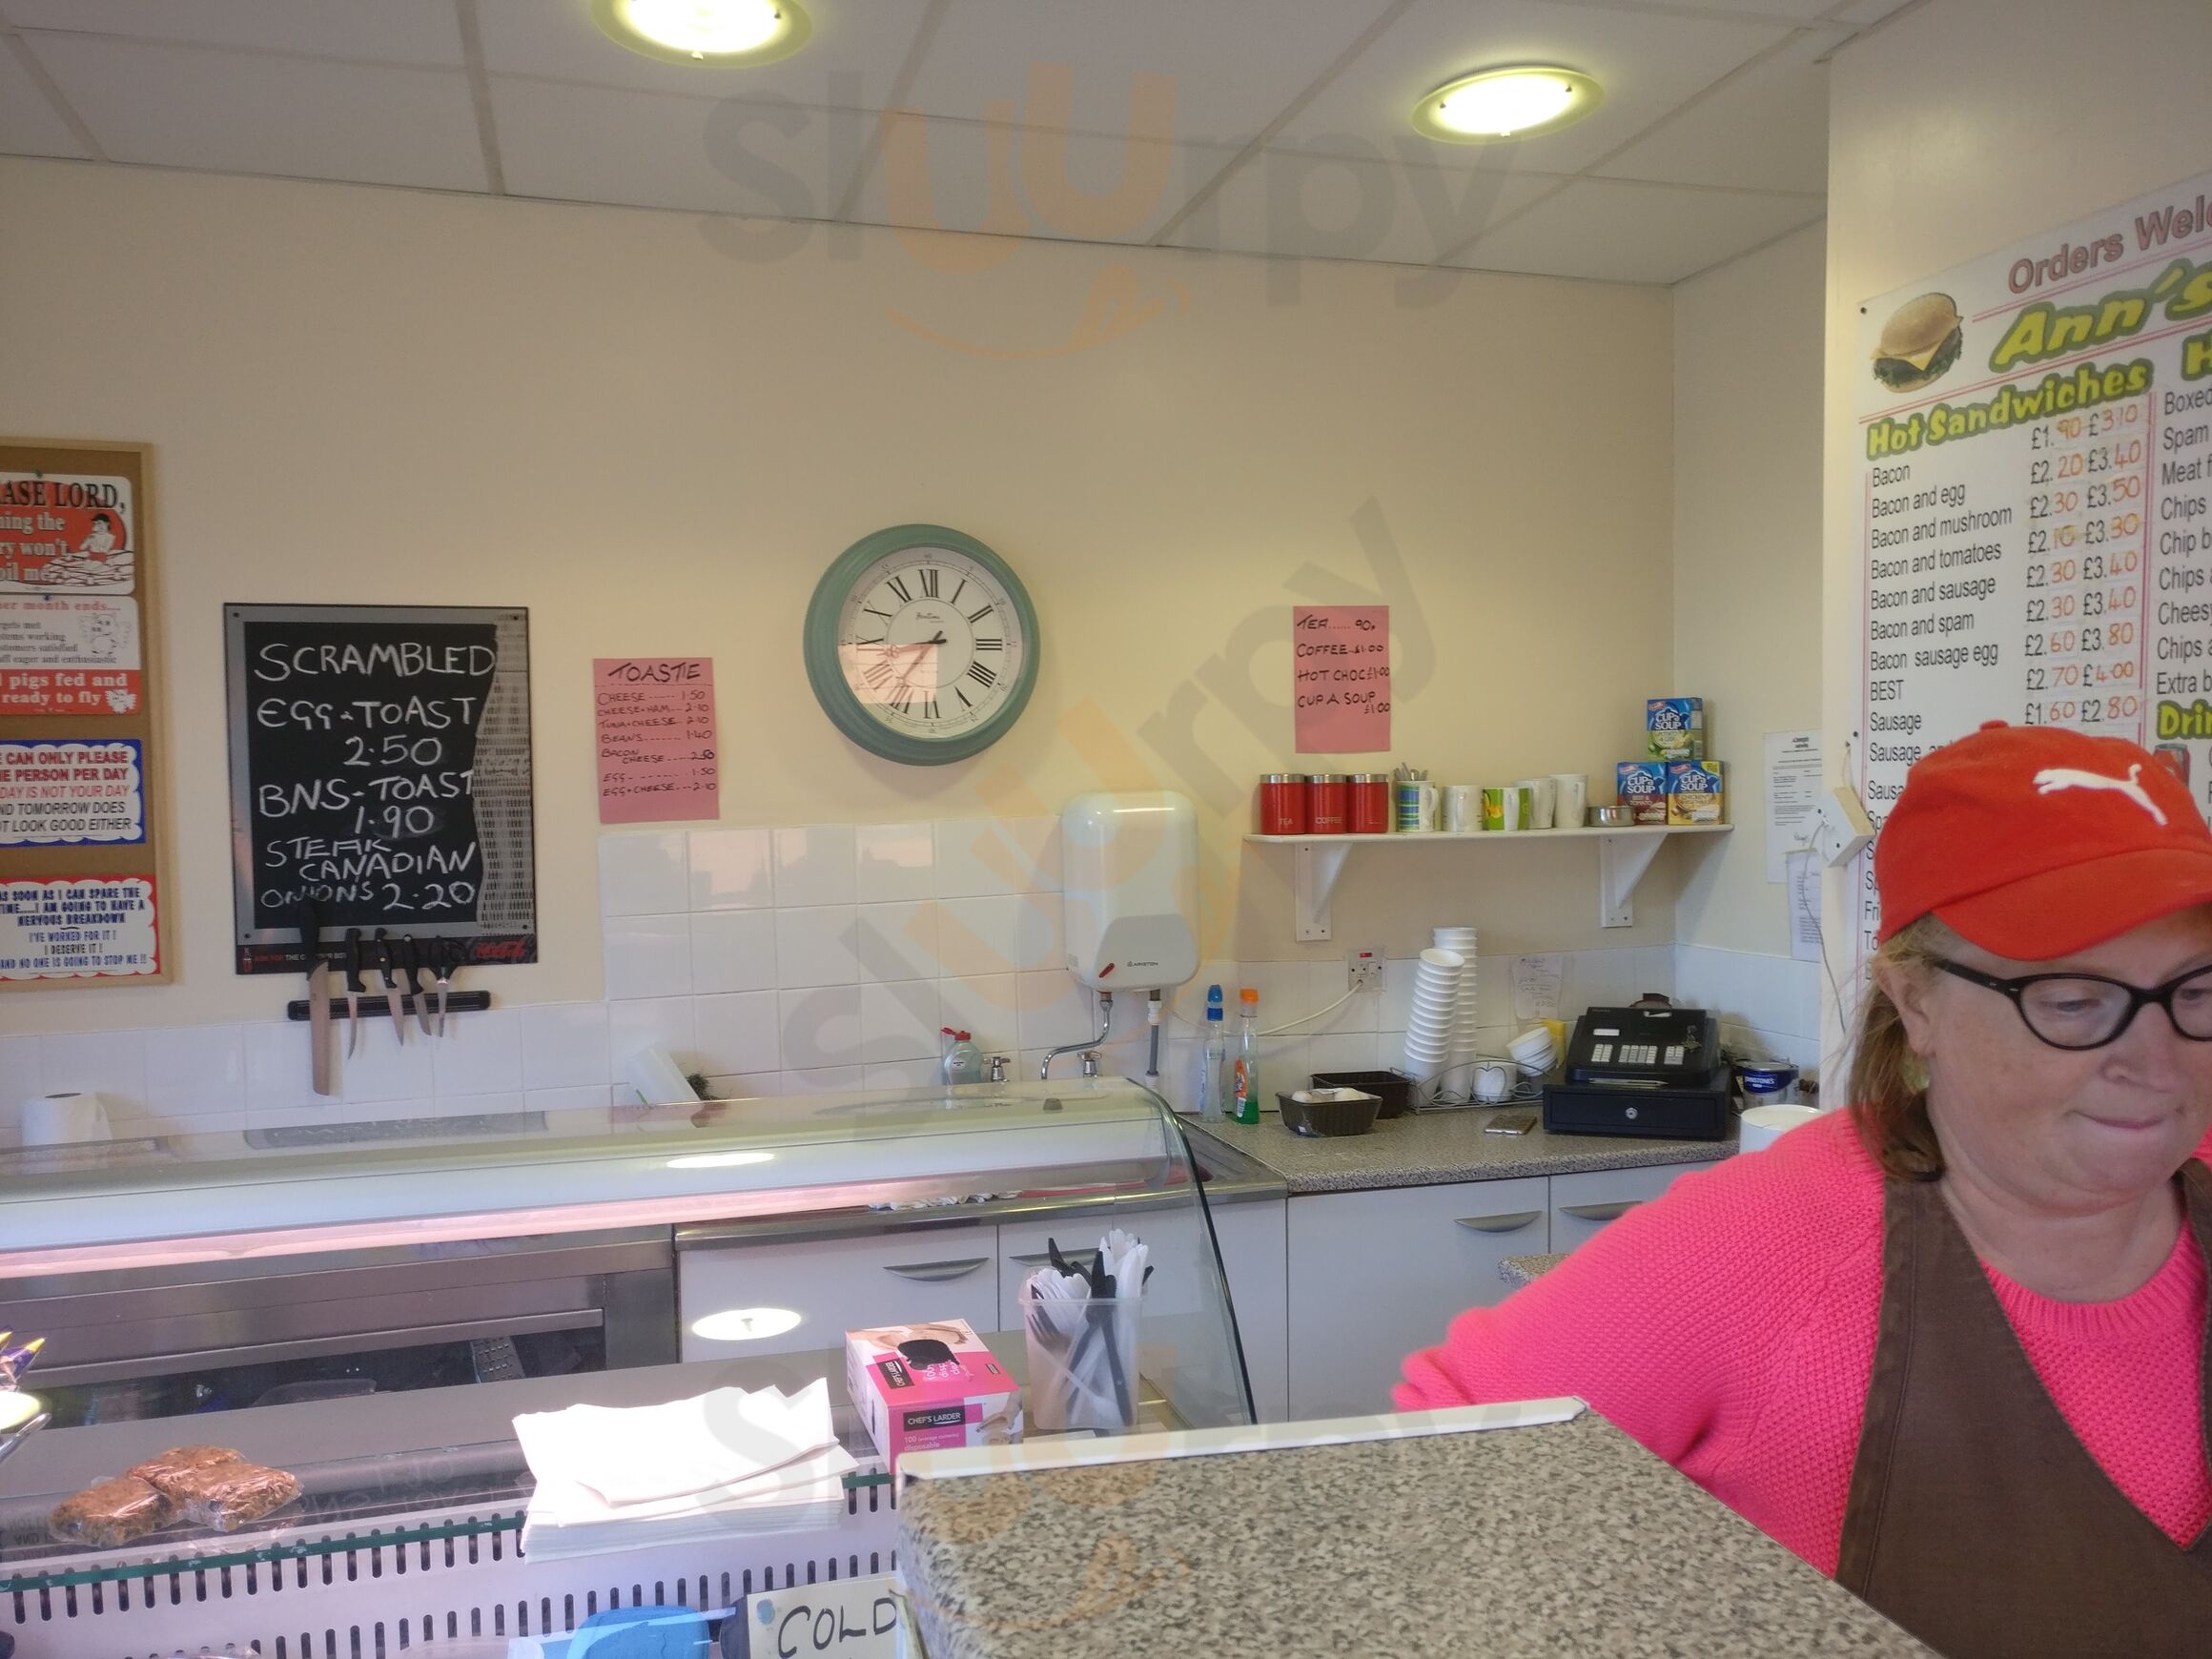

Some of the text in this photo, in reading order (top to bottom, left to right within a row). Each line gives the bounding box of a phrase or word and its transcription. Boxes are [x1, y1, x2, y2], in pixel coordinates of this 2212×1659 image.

[2008, 233, 2123, 294] Orders
[1867, 358, 2154, 460] Hot Sandwiches
[2163, 425, 2209, 455] Spam
[1873, 464, 1911, 487] Bacon
[2161, 458, 2202, 486] Meat
[54, 483, 125, 515] LORD,
[1872, 496, 1910, 519] Bacon
[1913, 484, 1936, 510] and
[1940, 483, 1965, 507] egg
[2161, 494, 2206, 522] Chips
[37, 512, 65, 531] the
[1872, 506, 2012, 549] Bacon and mushroom
[19, 538, 68, 556] won't
[2160, 529, 2197, 558] Chip
[1871, 559, 1908, 580] Bacon
[1912, 549, 1936, 573] and
[1939, 543, 2001, 568] tomatoes
[2159, 564, 2204, 593] Chips
[1871, 577, 1996, 610] Bacon and sausage
[1297, 615, 1329, 629] TEA
[1871, 613, 1975, 641] Bacon and spam
[1297, 644, 1348, 657] COFFEE
[1871, 644, 1998, 670] Bacon sausage egg
[2157, 635, 2202, 664] Chips
[255, 643, 497, 682] SCRAMBLED
[607, 662, 701, 683] TOASTIE
[9, 673, 128, 690] pigs fed and
[1298, 670, 1329, 682] HOT
[1334, 669, 1365, 681] CHOC
[2157, 671, 2197, 694] Extra
[2, 691, 51, 706] ready
[55, 692, 73, 704] to
[597, 692, 645, 706] CHEESE
[1298, 691, 1376, 707] CUP A SOUP
[1870, 680, 1904, 701] BEST
[1655, 722, 1681, 730] SOUP
[1870, 712, 1922, 735] Sausage
[602, 733, 644, 744] BEANS
[6, 751, 128, 765] CAN ONLY PLEASE
[344, 734, 442, 767] 2.50
[602, 748, 639, 758] BACON
[622, 755, 665, 764] CHEESE
[1869, 742, 1921, 767] Sausage
[15, 768, 69, 782] PERSON
[73, 768, 99, 781] PER
[103, 768, 129, 780] DAY
[603, 773, 626, 783] EGG
[26, 786, 131, 798] IS NOT YOUR DAY
[1627, 785, 1655, 793] SOUP
[1680, 783, 1708, 791] SOUP
[17, 802, 91, 815] TOMORROW
[92, 802, 125, 813] DOES
[11, 820, 47, 832] LOOK
[50, 819, 86, 831] GOOD
[89, 818, 132, 830] EITHER
[355, 806, 435, 839] 1.90
[265, 837, 392, 868] STEAK
[299, 841, 476, 882] CANADIAN
[12, 890, 38, 901] SOON
[42, 890, 53, 900] AS
[66, 889, 85, 899] CAN
[89, 888, 119, 899] SPARE
[122, 888, 141, 898] THE
[381, 880, 476, 911] 2.20
[61, 901, 91, 912] GOING
[95, 901, 107, 911] TO
[112, 900, 134, 911] HAVE
[138, 900, 145, 910] A
[17, 912, 126, 927] NERVOUS BREAKDOWN
[29, 932, 100, 943] I'VE WORKED FOR
[51, 944, 85, 954] DESERVE
[19, 958, 31, 969] NO
[33, 957, 50, 968] ONE
[52, 957, 60, 967] IS
[63, 956, 88, 967] GOING
[92, 955, 101, 966] TO
[104, 955, 123, 966] STOP
[126, 954, 137, 965] ME
[908, 1412, 962, 1425] CHEF'S LARDER
[778, 1597, 897, 1659] COLD
